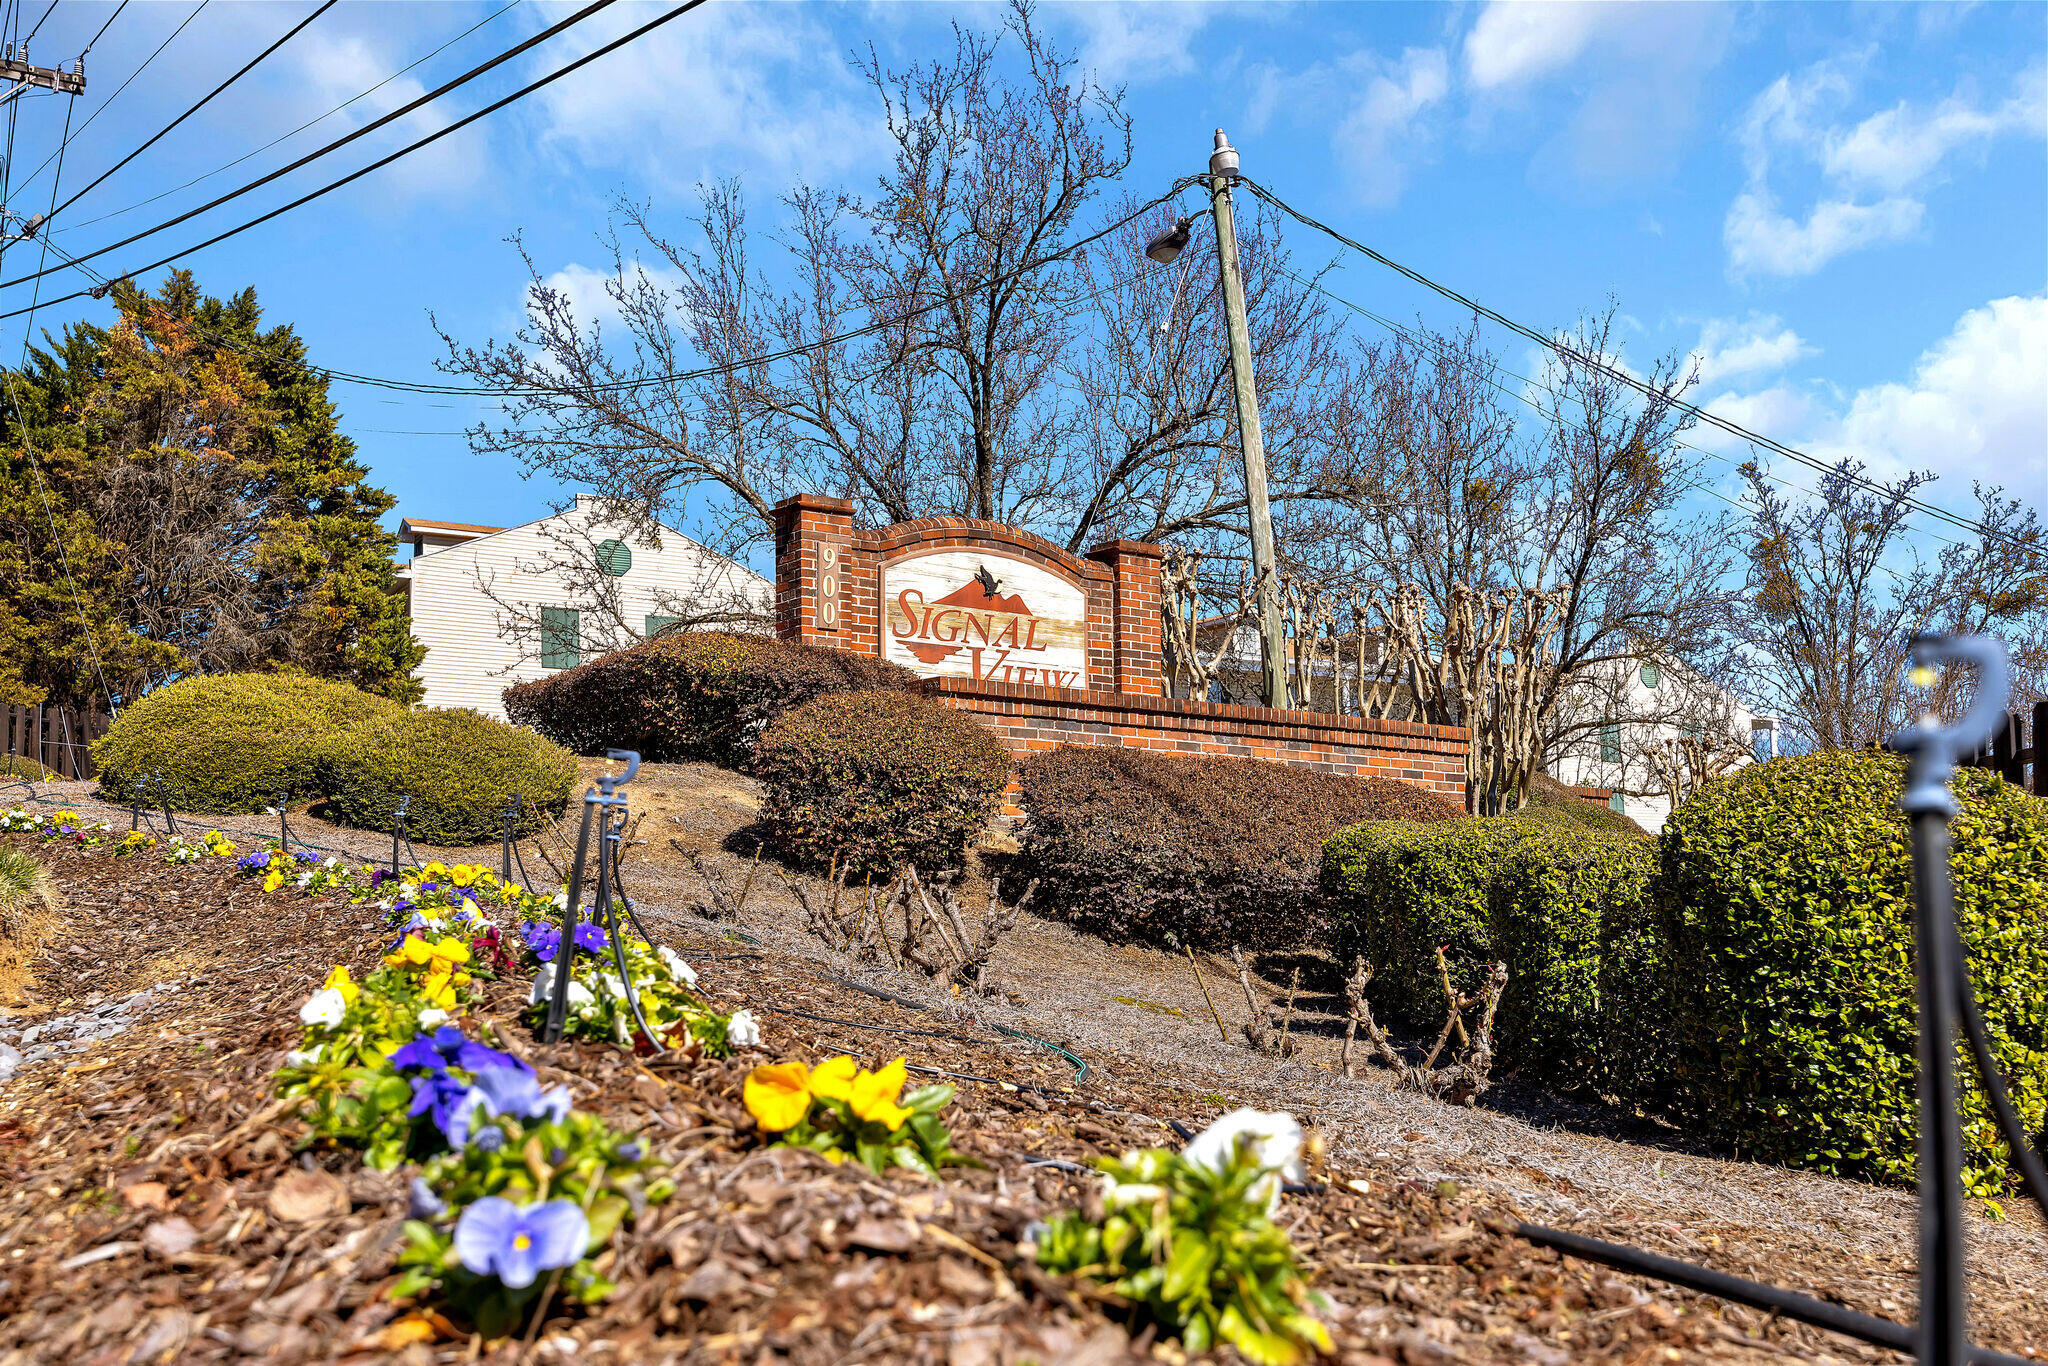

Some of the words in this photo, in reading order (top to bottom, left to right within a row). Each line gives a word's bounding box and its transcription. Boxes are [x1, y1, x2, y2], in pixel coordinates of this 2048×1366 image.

[822, 547, 836, 625] 900
[891, 588, 1048, 651] SIGNAL
[966, 646, 1080, 688] VIEW
